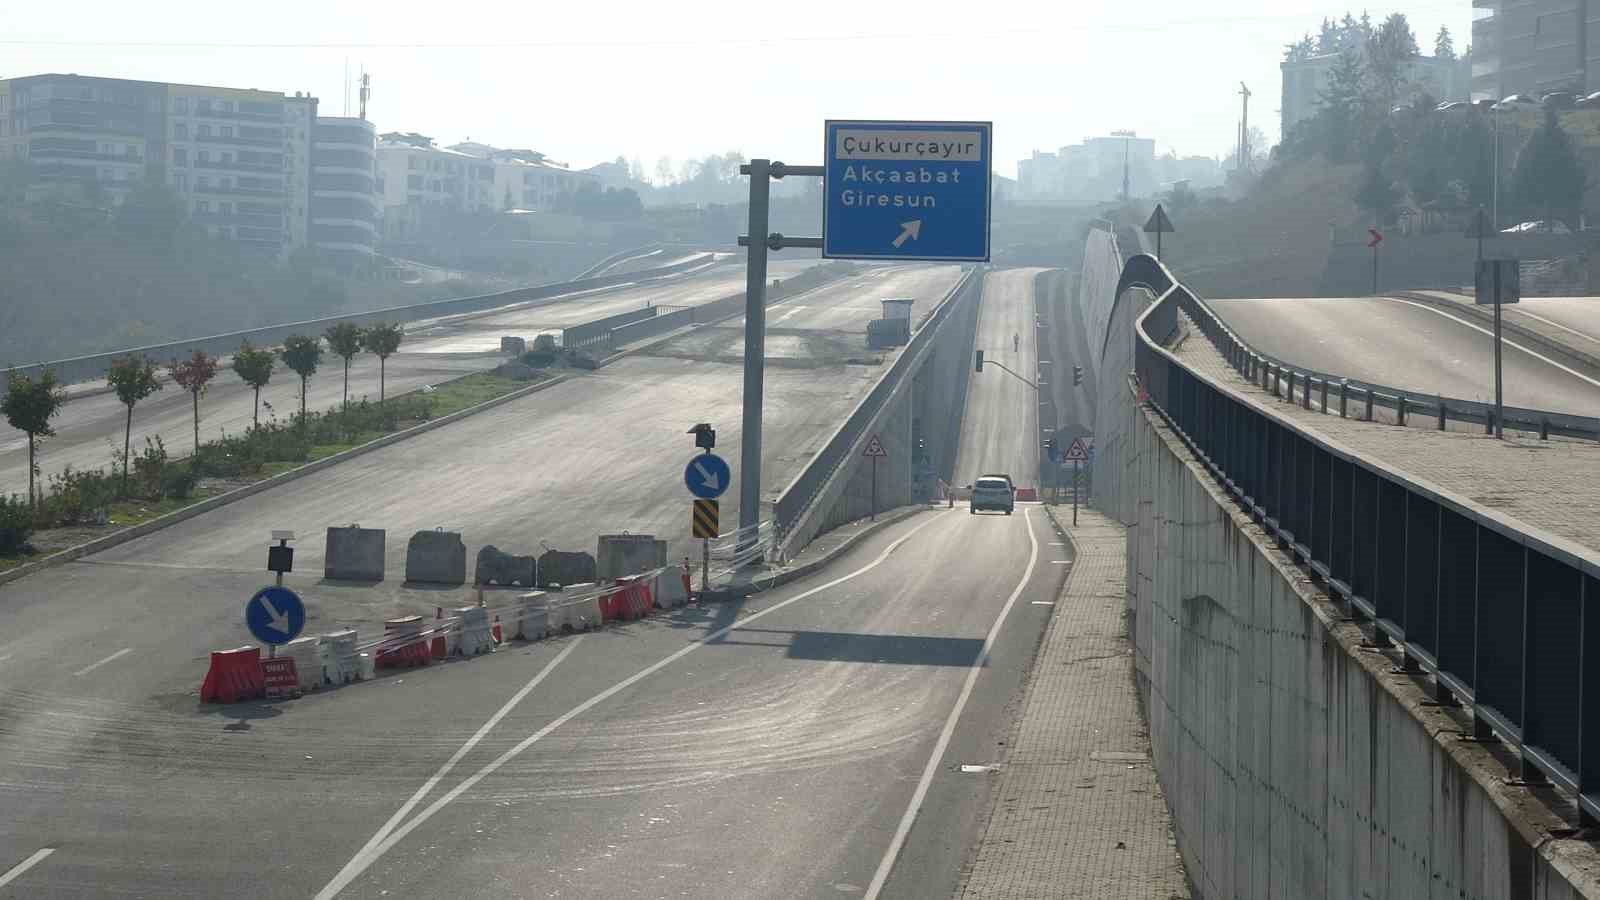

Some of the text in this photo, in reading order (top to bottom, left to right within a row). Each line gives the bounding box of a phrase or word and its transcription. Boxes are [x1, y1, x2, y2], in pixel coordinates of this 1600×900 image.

[843, 136, 975, 158] Çukurçayır
[842, 165, 961, 184] Akçaabat
[841, 189, 936, 208] Giresun
